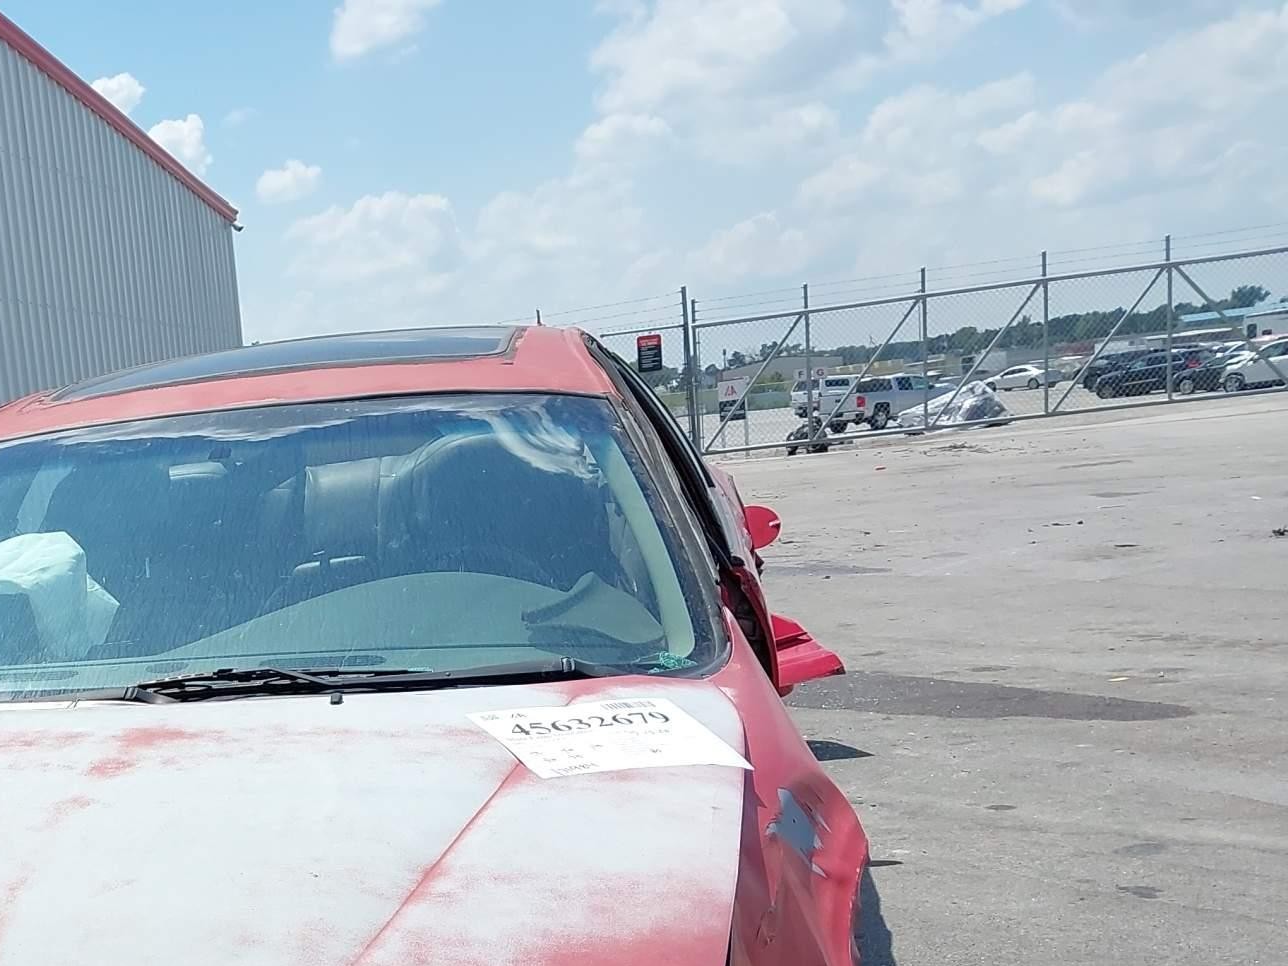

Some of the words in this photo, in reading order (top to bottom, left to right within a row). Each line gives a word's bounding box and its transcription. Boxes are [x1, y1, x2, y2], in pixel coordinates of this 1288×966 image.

[798, 370, 805, 379] F
[816, 368, 825, 377] G
[511, 711, 670, 736] 45632679
